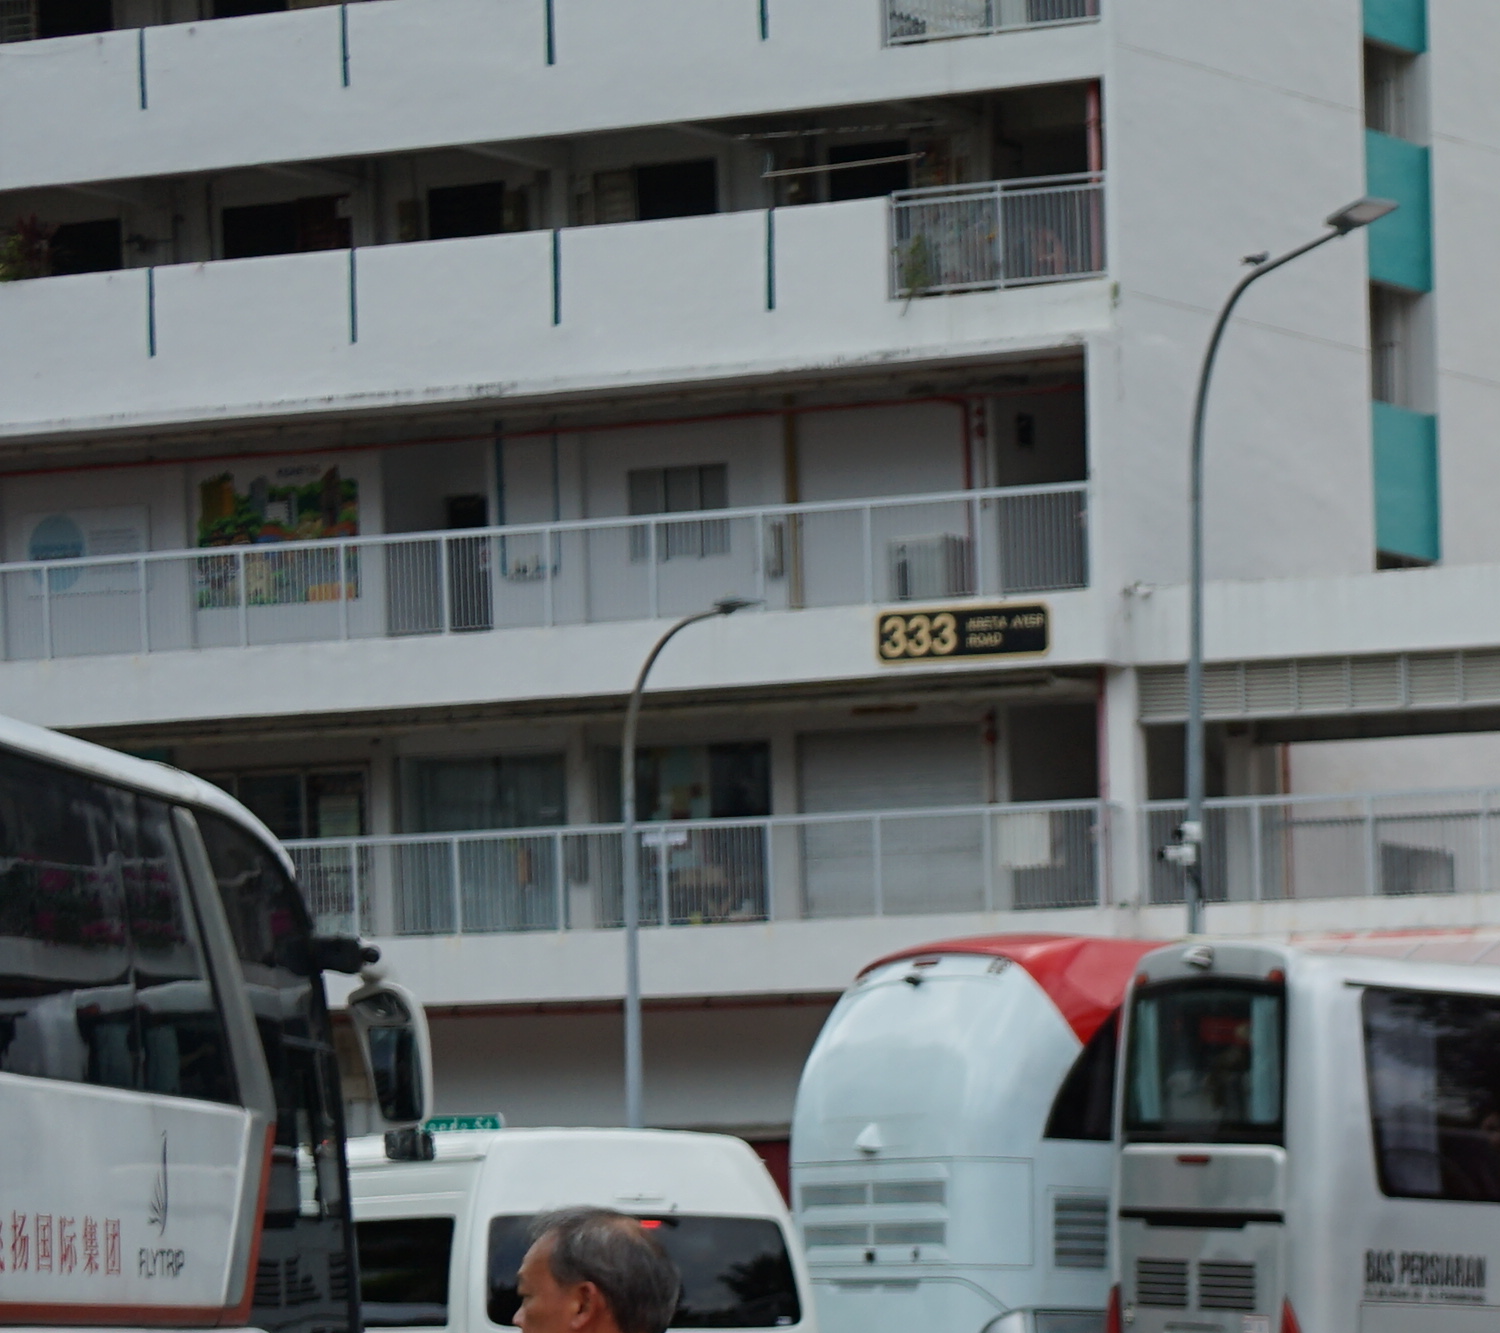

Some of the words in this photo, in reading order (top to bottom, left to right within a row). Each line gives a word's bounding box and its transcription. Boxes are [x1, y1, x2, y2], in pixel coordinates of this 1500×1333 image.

[881, 613, 957, 657] 333
[966, 631, 1003, 648] ROAD
[138, 1247, 185, 1279] FLYTRIP
[1365, 1249, 1395, 1284] BAS
[1400, 1252, 1487, 1288] PERSIARAN
